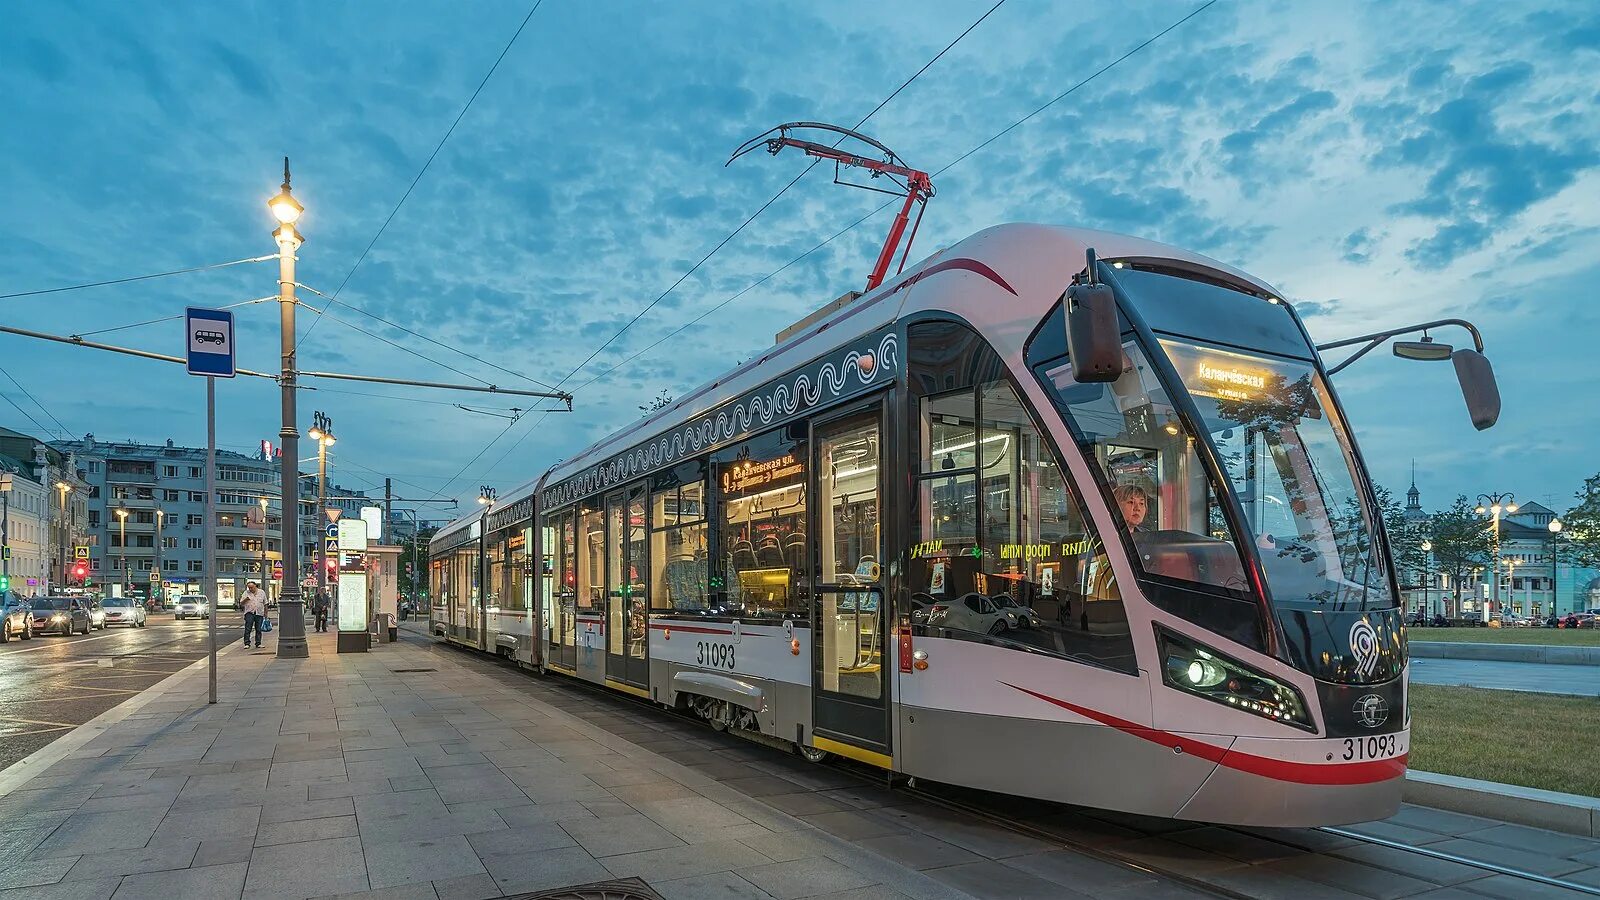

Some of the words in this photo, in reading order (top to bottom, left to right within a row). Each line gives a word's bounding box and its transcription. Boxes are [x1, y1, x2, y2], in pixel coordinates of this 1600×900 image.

[1199, 364, 1264, 388] Каланчёвская
[723, 472, 730, 494] 9
[697, 641, 735, 670] 31093
[1343, 735, 1395, 761] 31093
